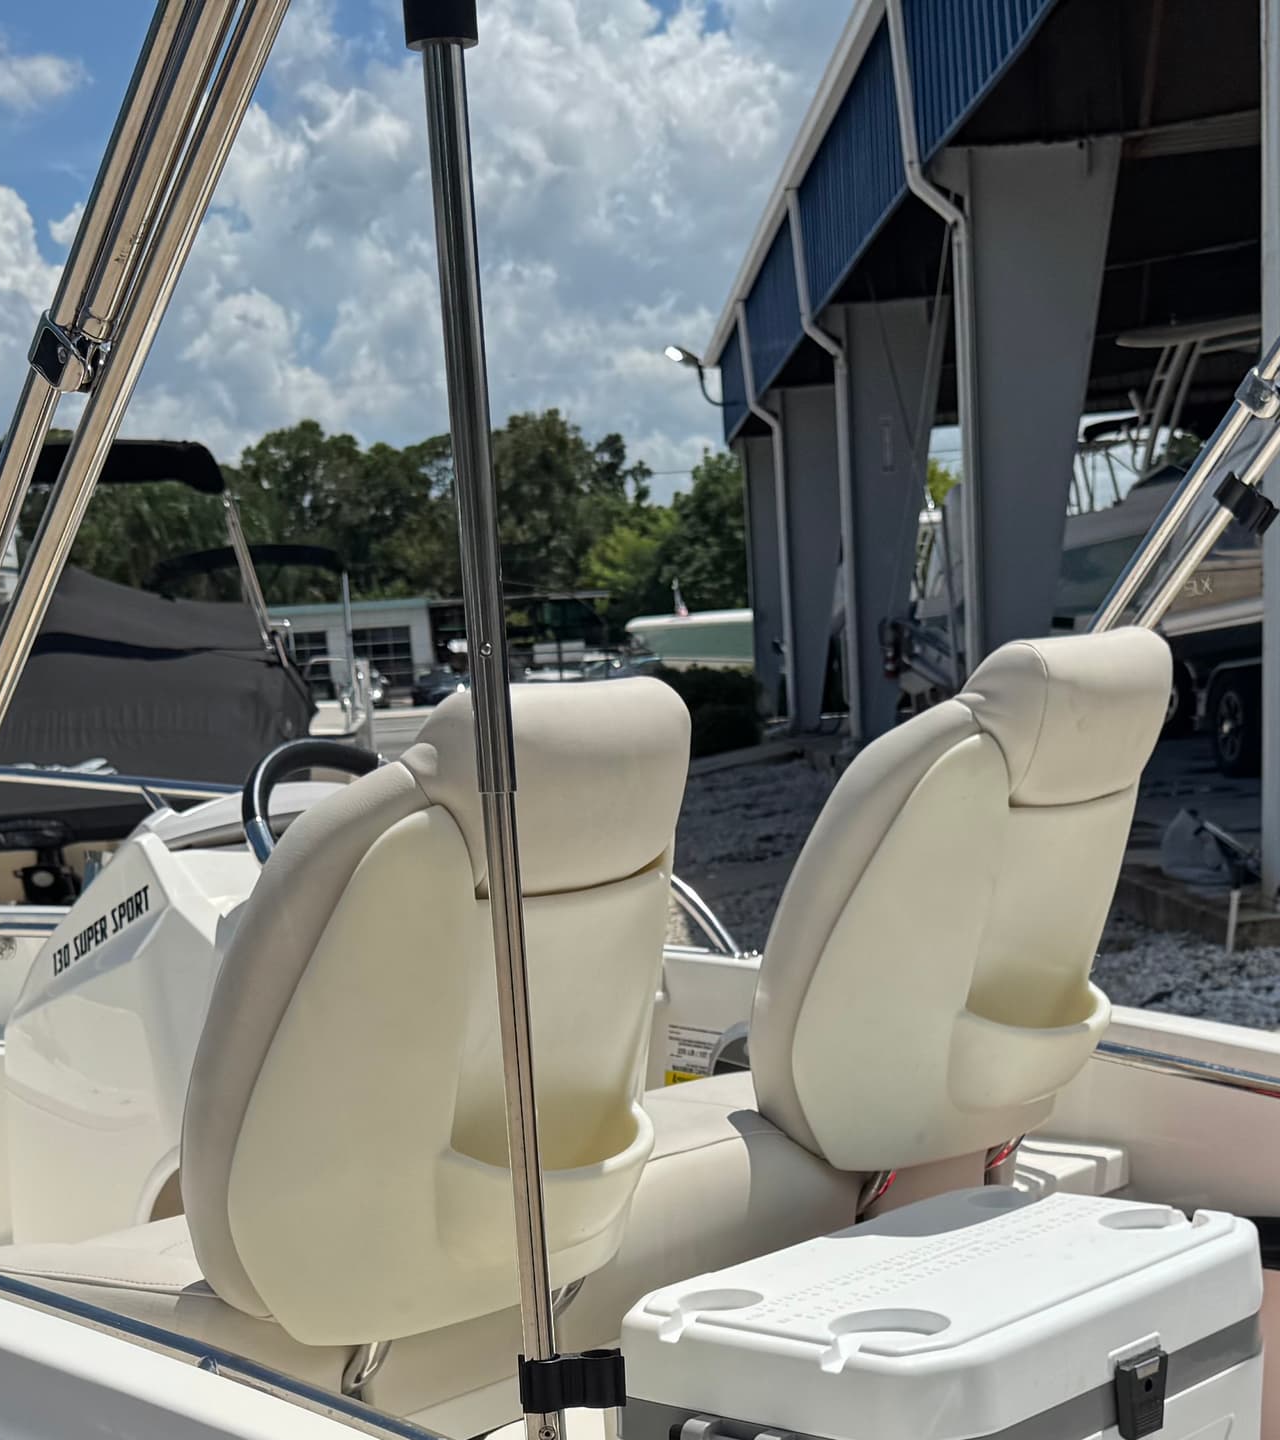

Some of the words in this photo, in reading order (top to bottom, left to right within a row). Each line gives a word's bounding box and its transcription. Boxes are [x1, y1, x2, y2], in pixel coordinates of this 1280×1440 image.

[53, 942, 71, 977] 130
[74, 916, 108, 962] SUPER
[111, 885, 150, 933] SPORT
